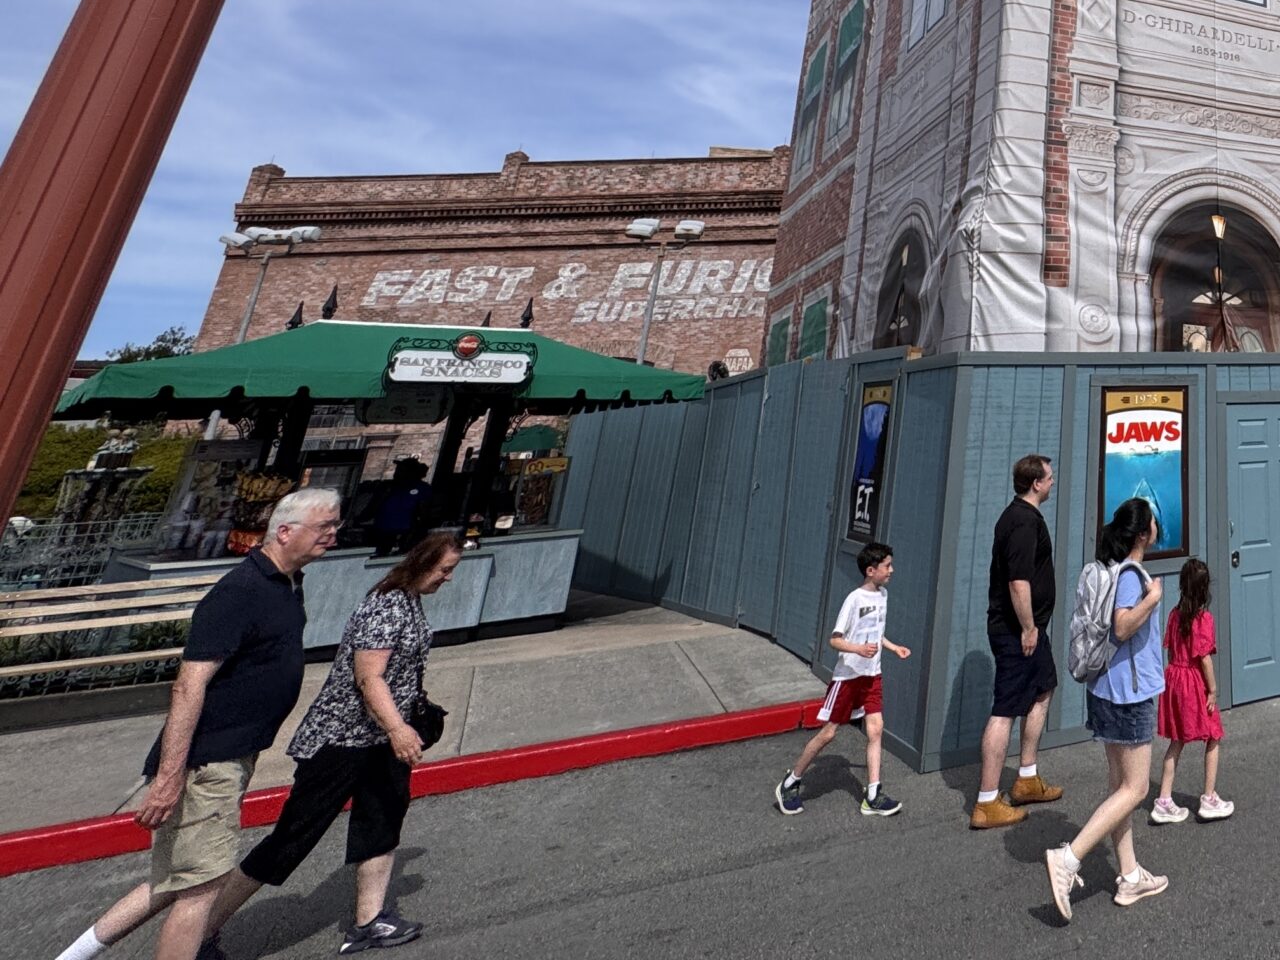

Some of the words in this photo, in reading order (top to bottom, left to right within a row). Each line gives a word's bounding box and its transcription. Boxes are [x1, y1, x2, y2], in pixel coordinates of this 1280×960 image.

[360, 266, 535, 306] FAST
[542, 262, 587, 300] &
[399, 356, 432, 367] SAN
[436, 358, 524, 369] FRANCISCO
[420, 366, 502, 379] SNACKS
[1134, 393, 1159, 405] 1975
[1107, 420, 1181, 444] JAWS
